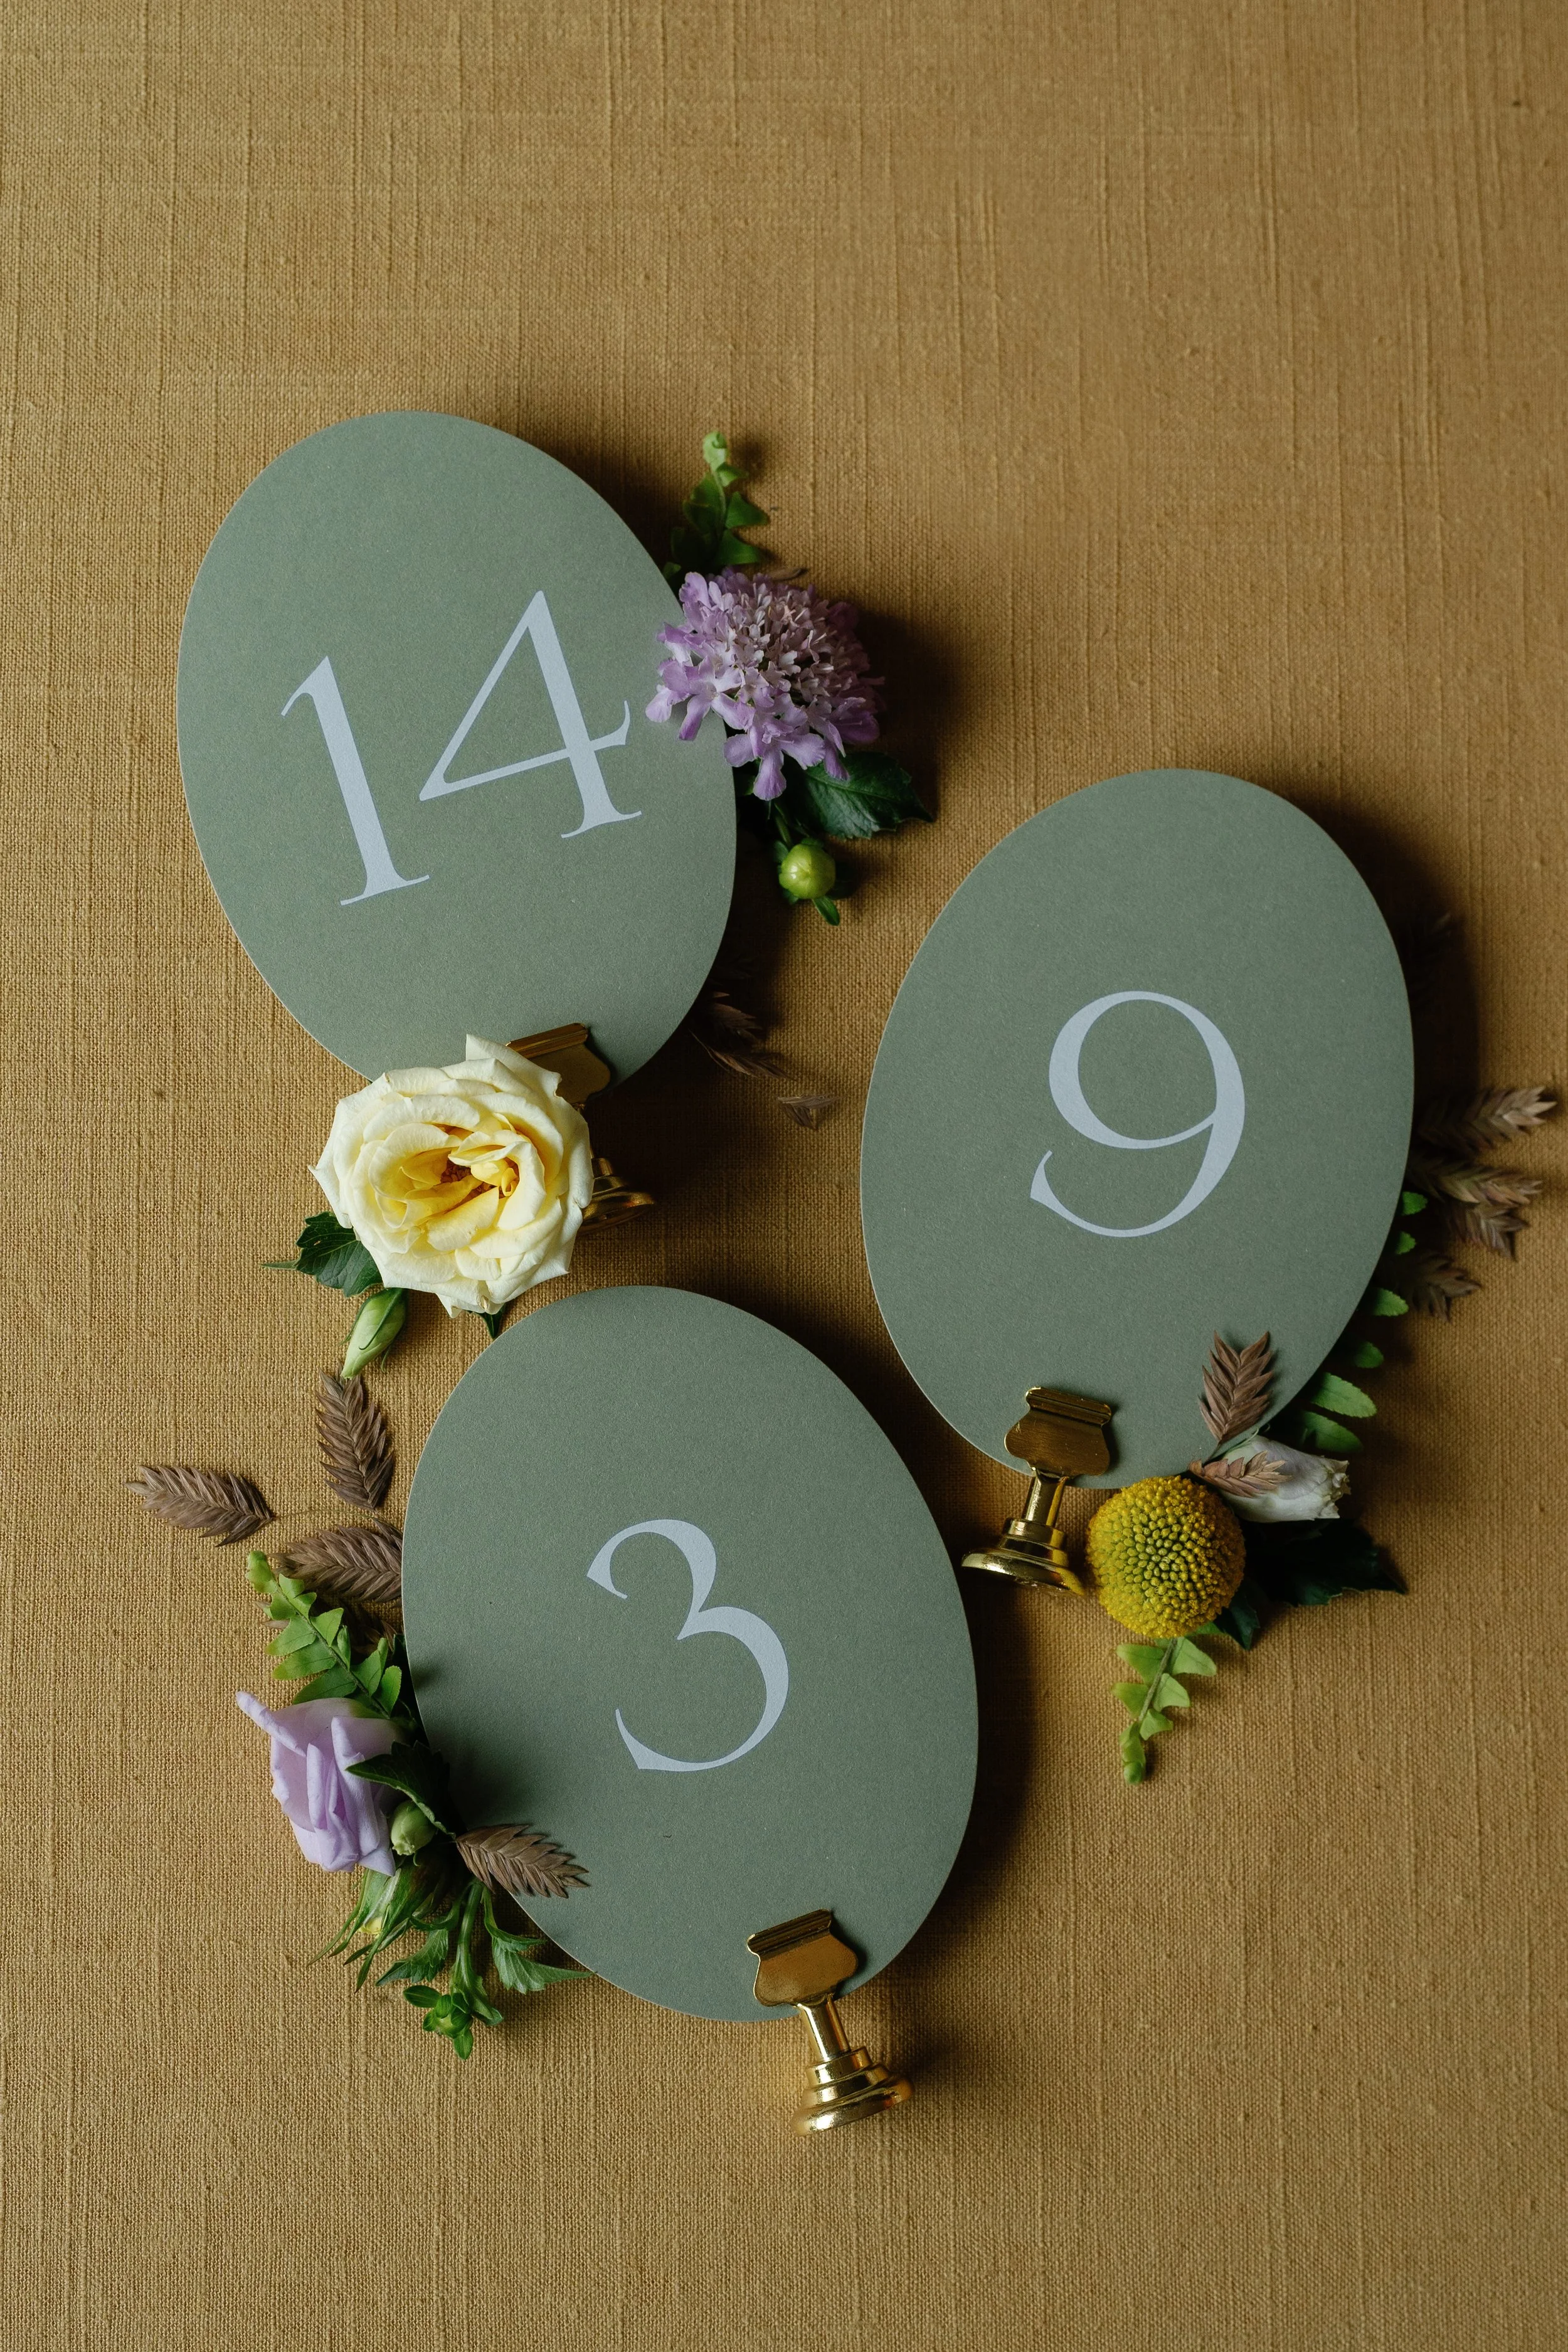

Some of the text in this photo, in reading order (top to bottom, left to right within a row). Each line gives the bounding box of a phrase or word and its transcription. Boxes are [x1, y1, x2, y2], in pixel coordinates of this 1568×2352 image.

[280, 590, 642, 906] 14
[1030, 990, 1246, 1239] 9
[586, 1518, 790, 1773] 3
